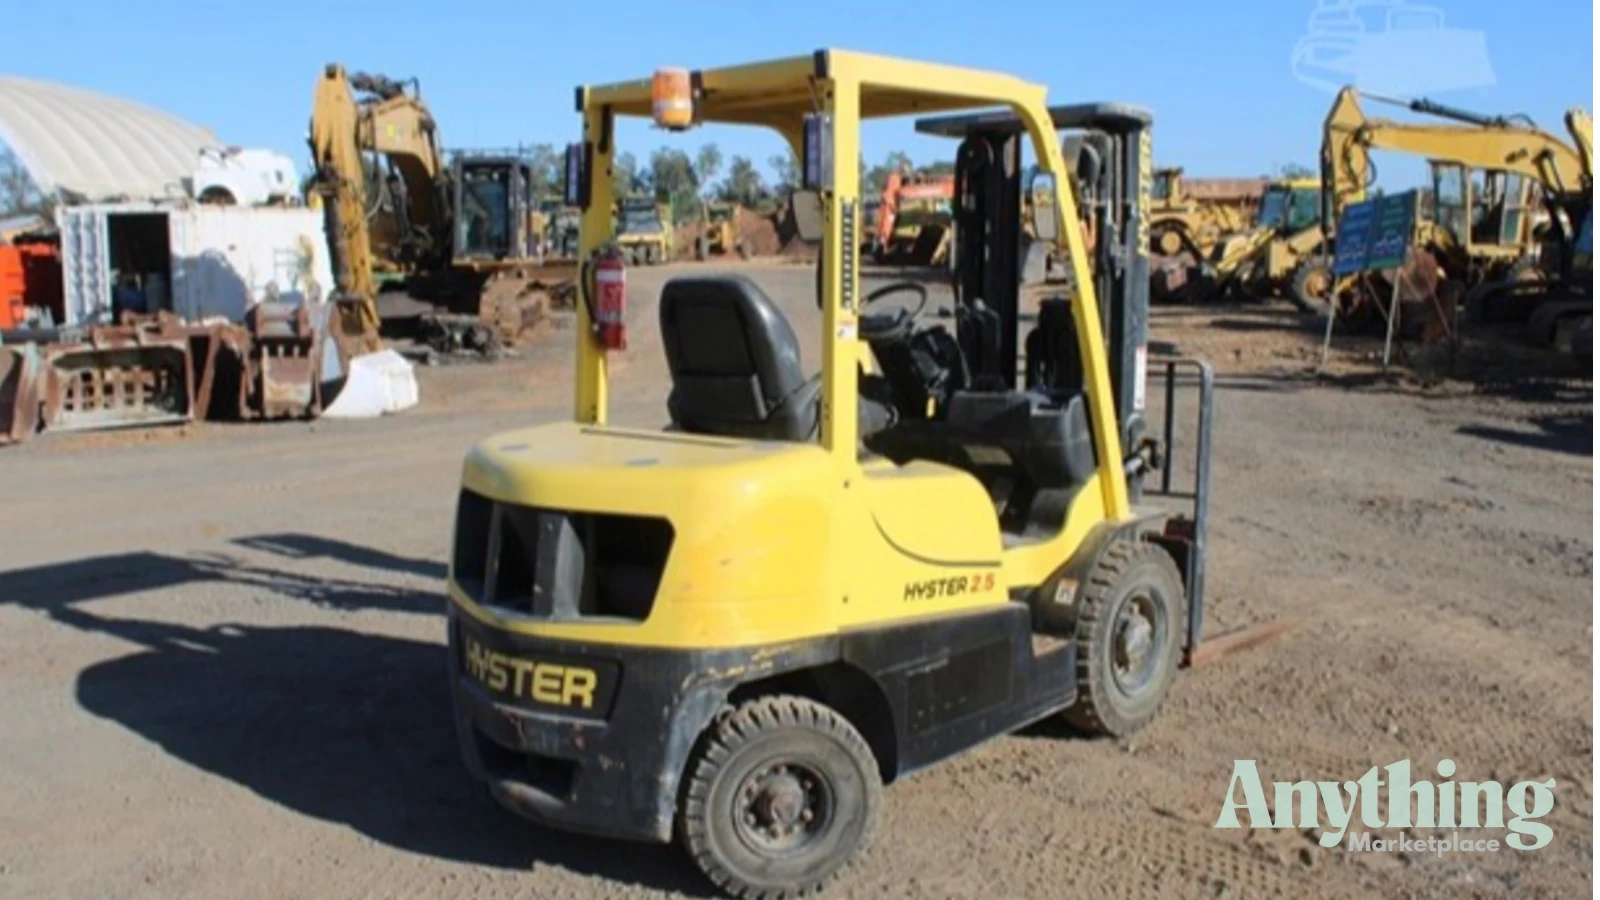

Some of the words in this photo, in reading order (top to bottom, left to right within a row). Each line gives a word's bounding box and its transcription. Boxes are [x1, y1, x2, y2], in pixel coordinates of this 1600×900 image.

[904, 577, 968, 600] HYSTER
[970, 573, 995, 593] 2.5
[465, 640, 597, 708] HYSTER
